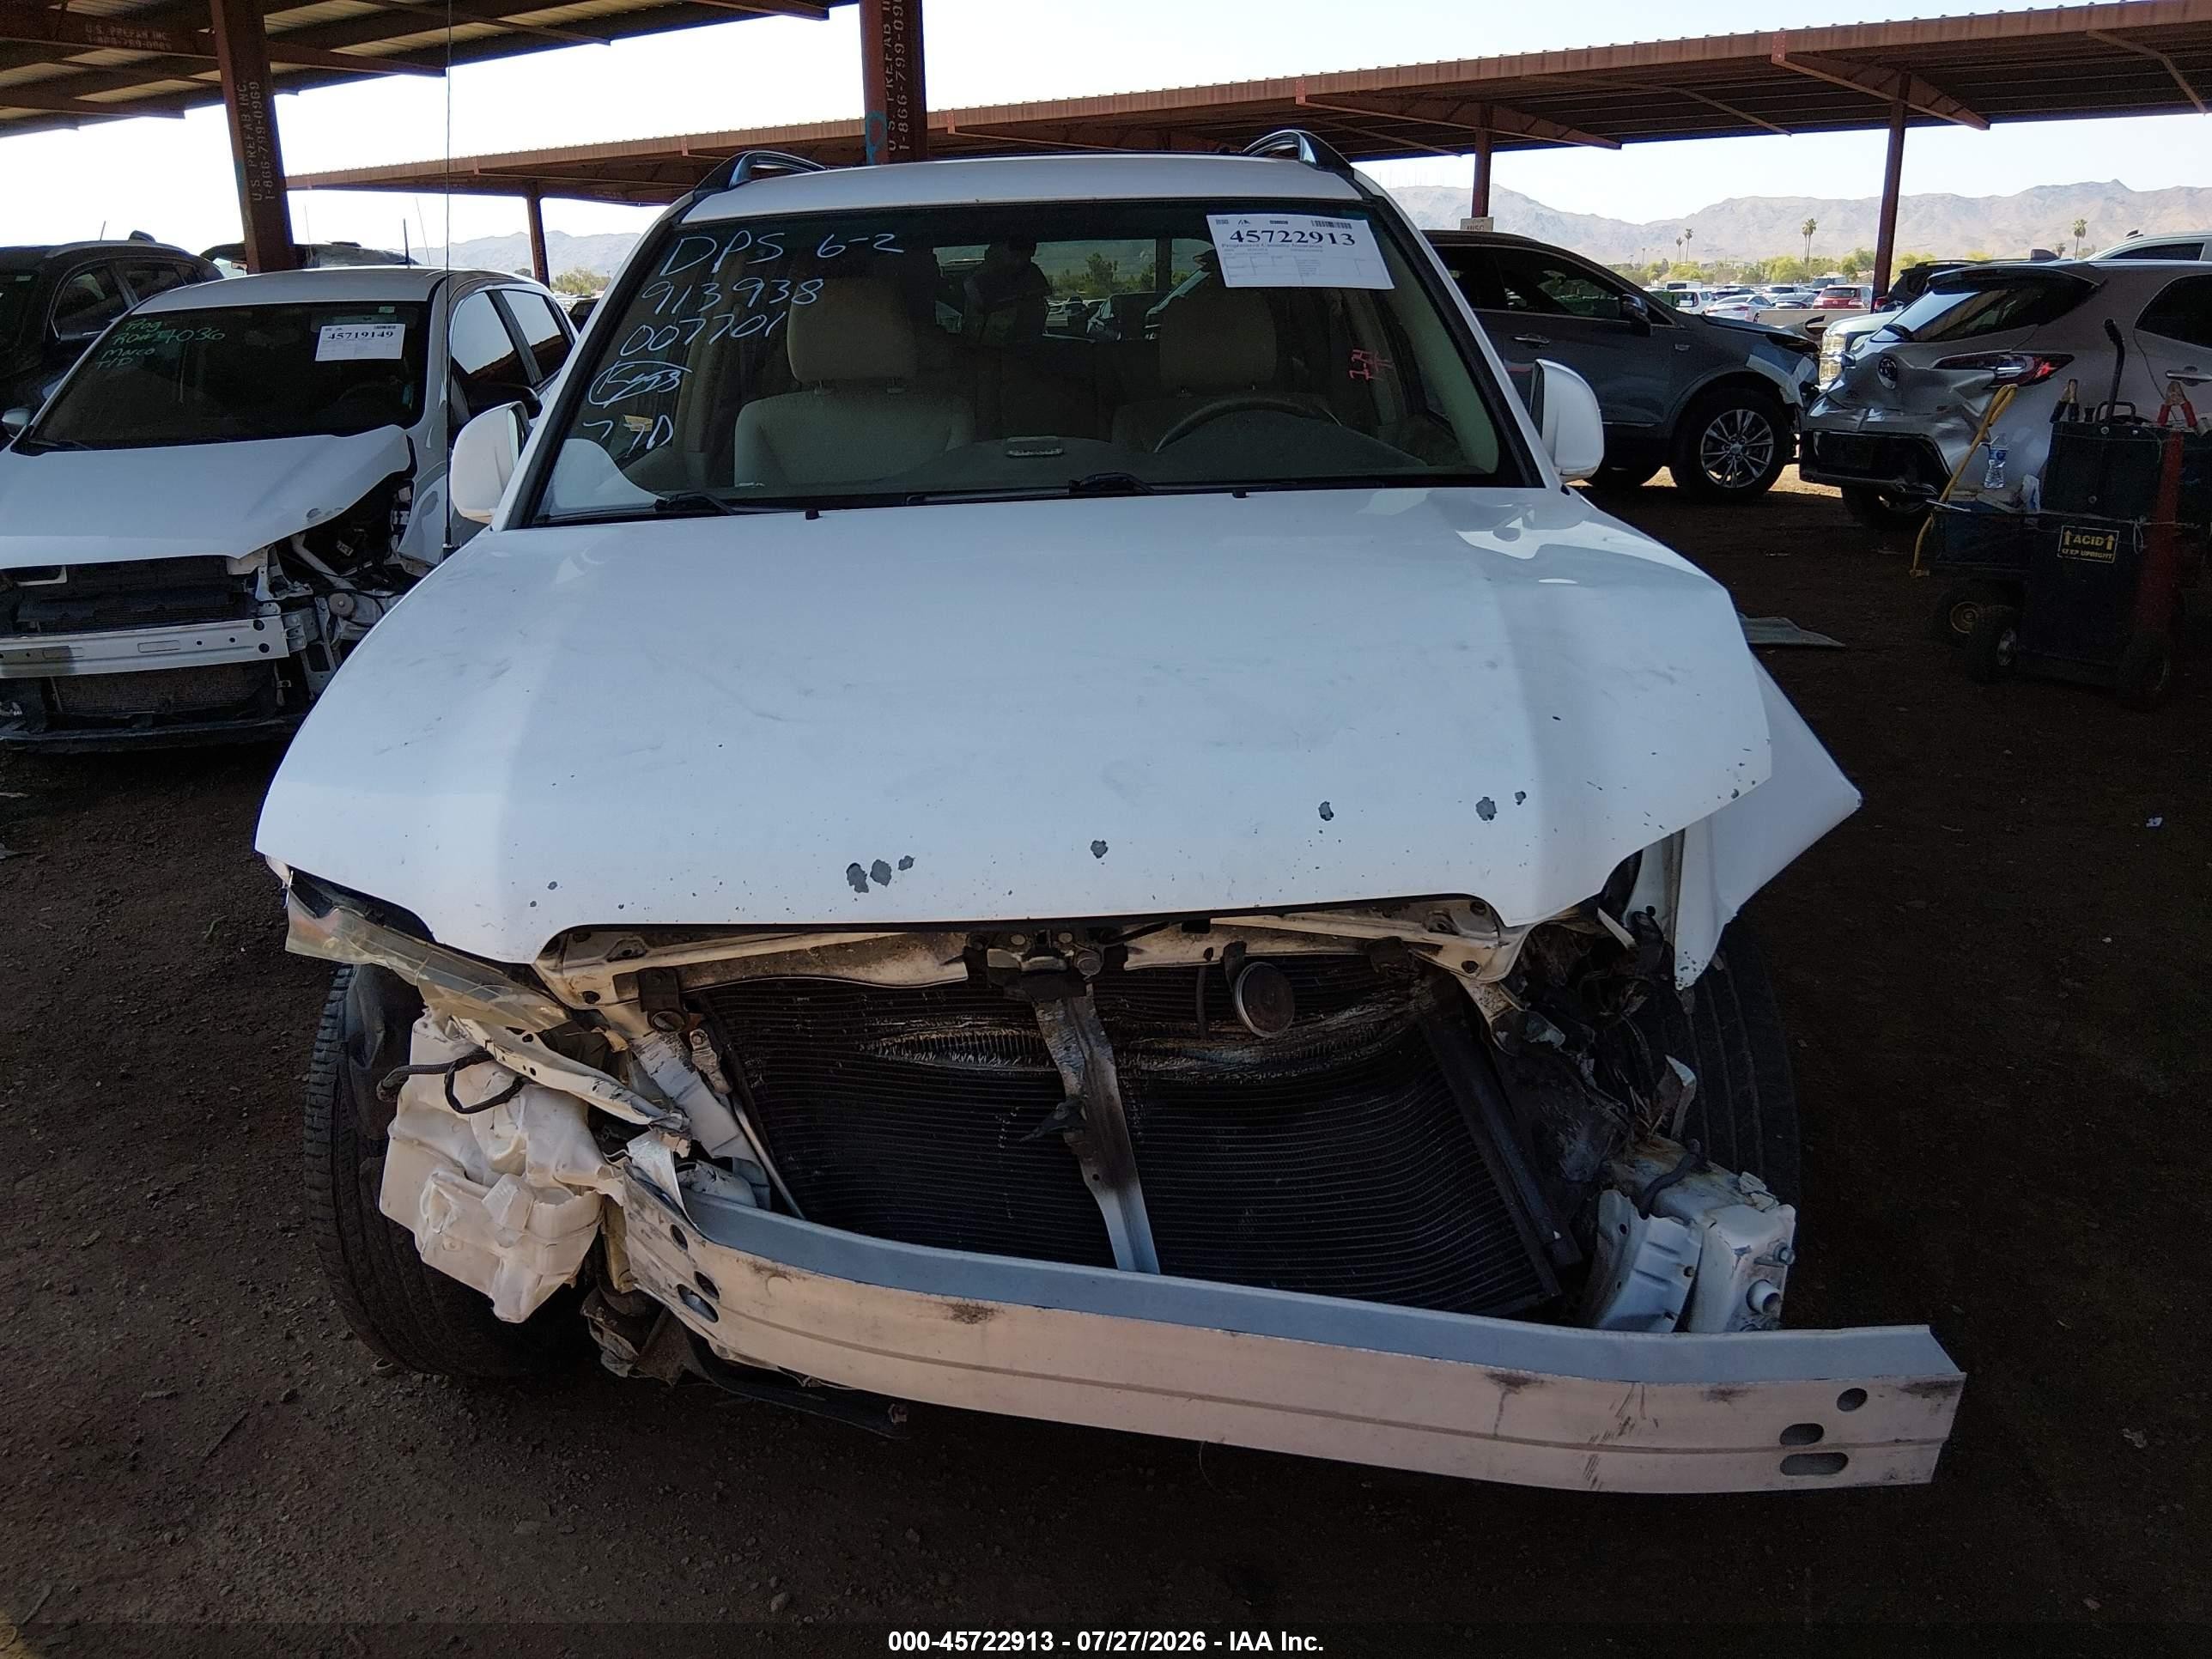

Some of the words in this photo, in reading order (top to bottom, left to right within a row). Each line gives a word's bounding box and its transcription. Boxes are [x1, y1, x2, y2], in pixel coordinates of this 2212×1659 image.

[893, 0, 910, 150] 1-866-799-09
[240, 113, 257, 167] PREFAB
[659, 230, 785, 276] DPS
[817, 233, 905, 258] 6-2
[1230, 229, 1355, 246] 45722913
[328, 331, 393, 339] 45719149
[619, 312, 787, 356] 007701
[2073, 535, 2105, 546] ACID
